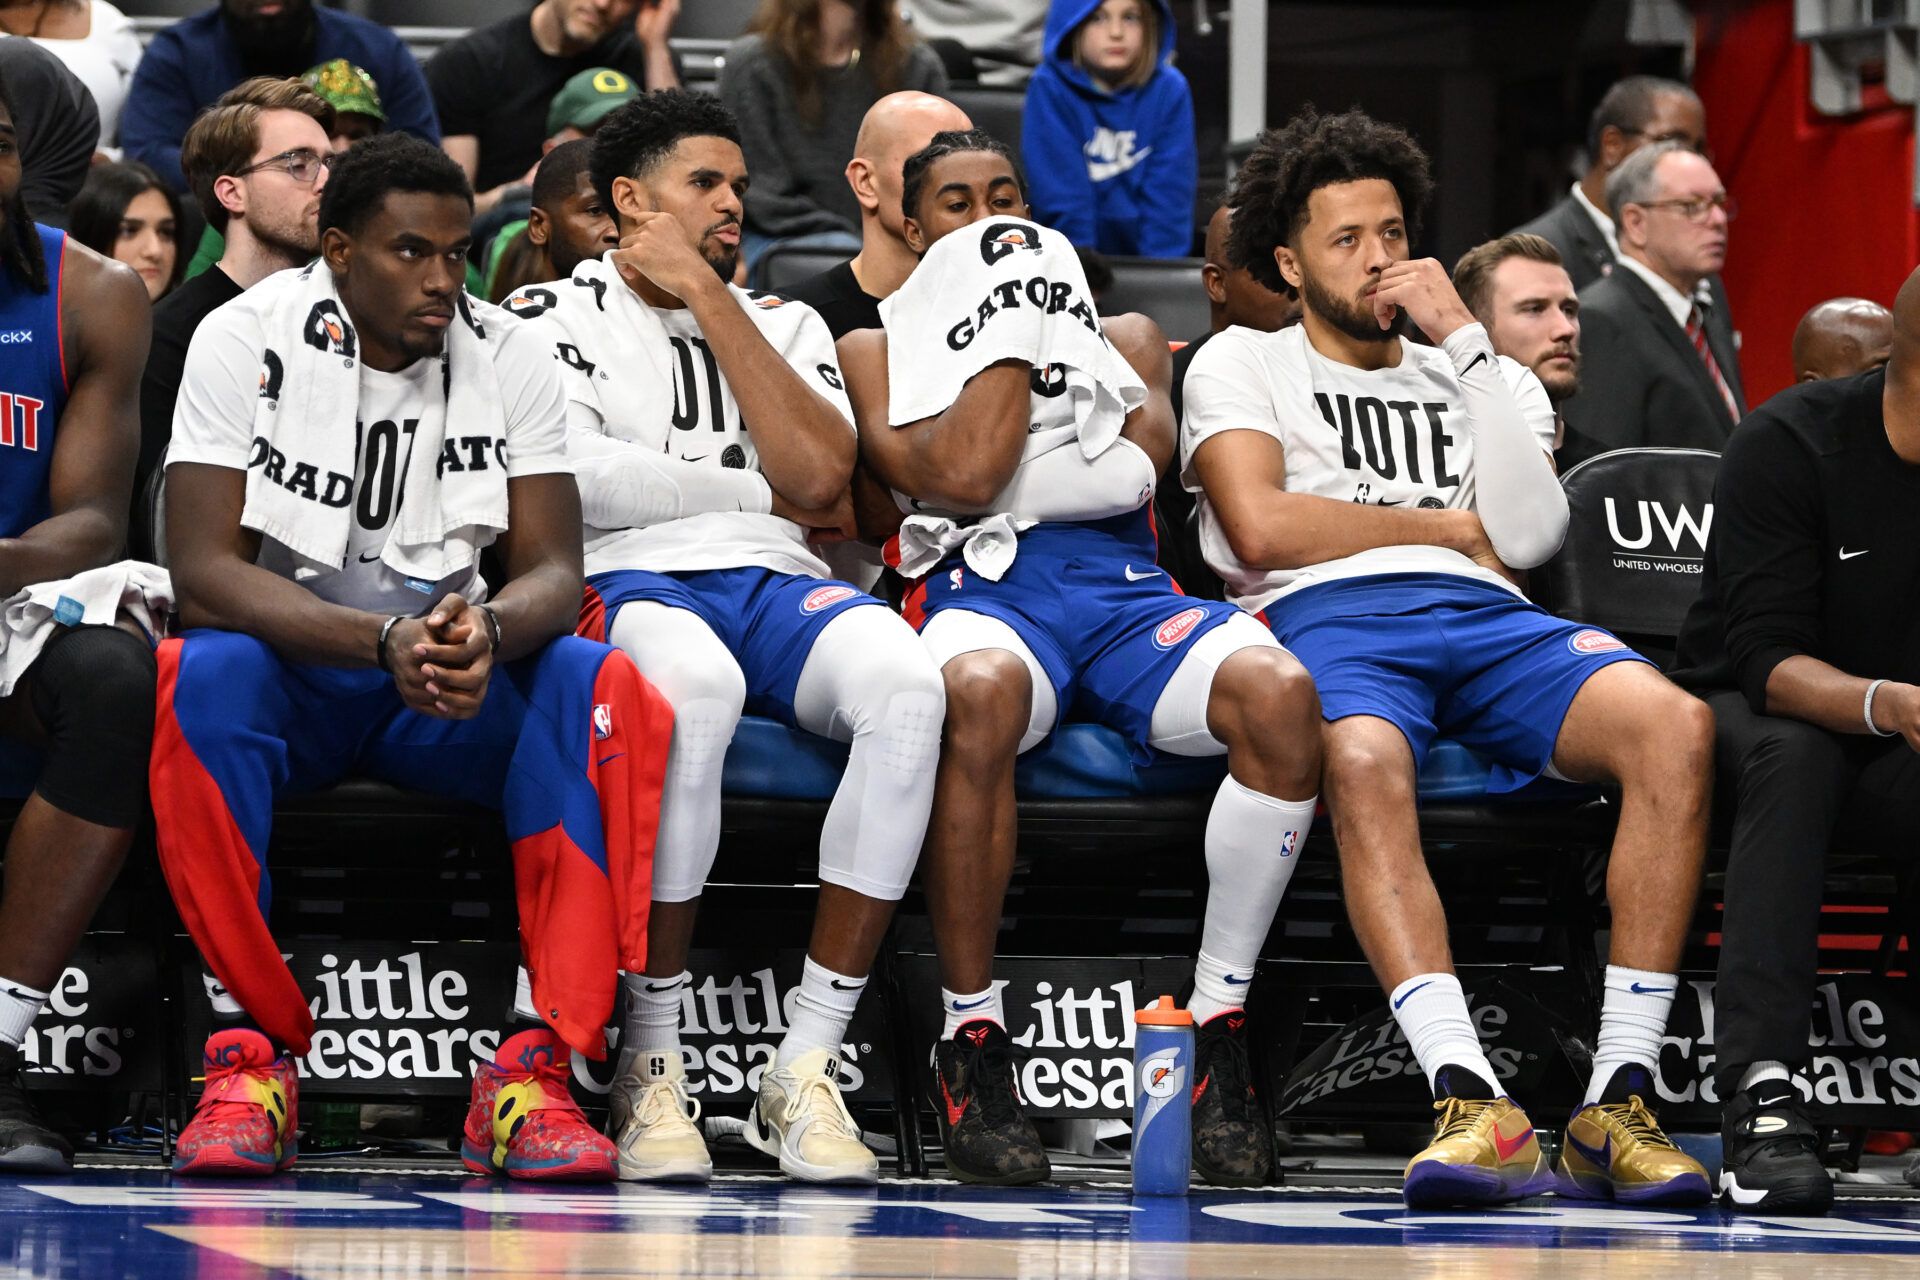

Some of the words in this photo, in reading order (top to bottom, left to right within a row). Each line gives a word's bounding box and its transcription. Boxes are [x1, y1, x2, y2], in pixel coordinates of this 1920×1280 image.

[946, 276, 1109, 352] GATORA
[1313, 392, 1460, 489] VOTE
[1613, 558, 1651, 571] UNITED
[284, 952, 469, 1021] ittle
[617, 968, 803, 1035] ittl
[991, 979, 1157, 1050] Littl
[1141, 1058, 1175, 1099] G
